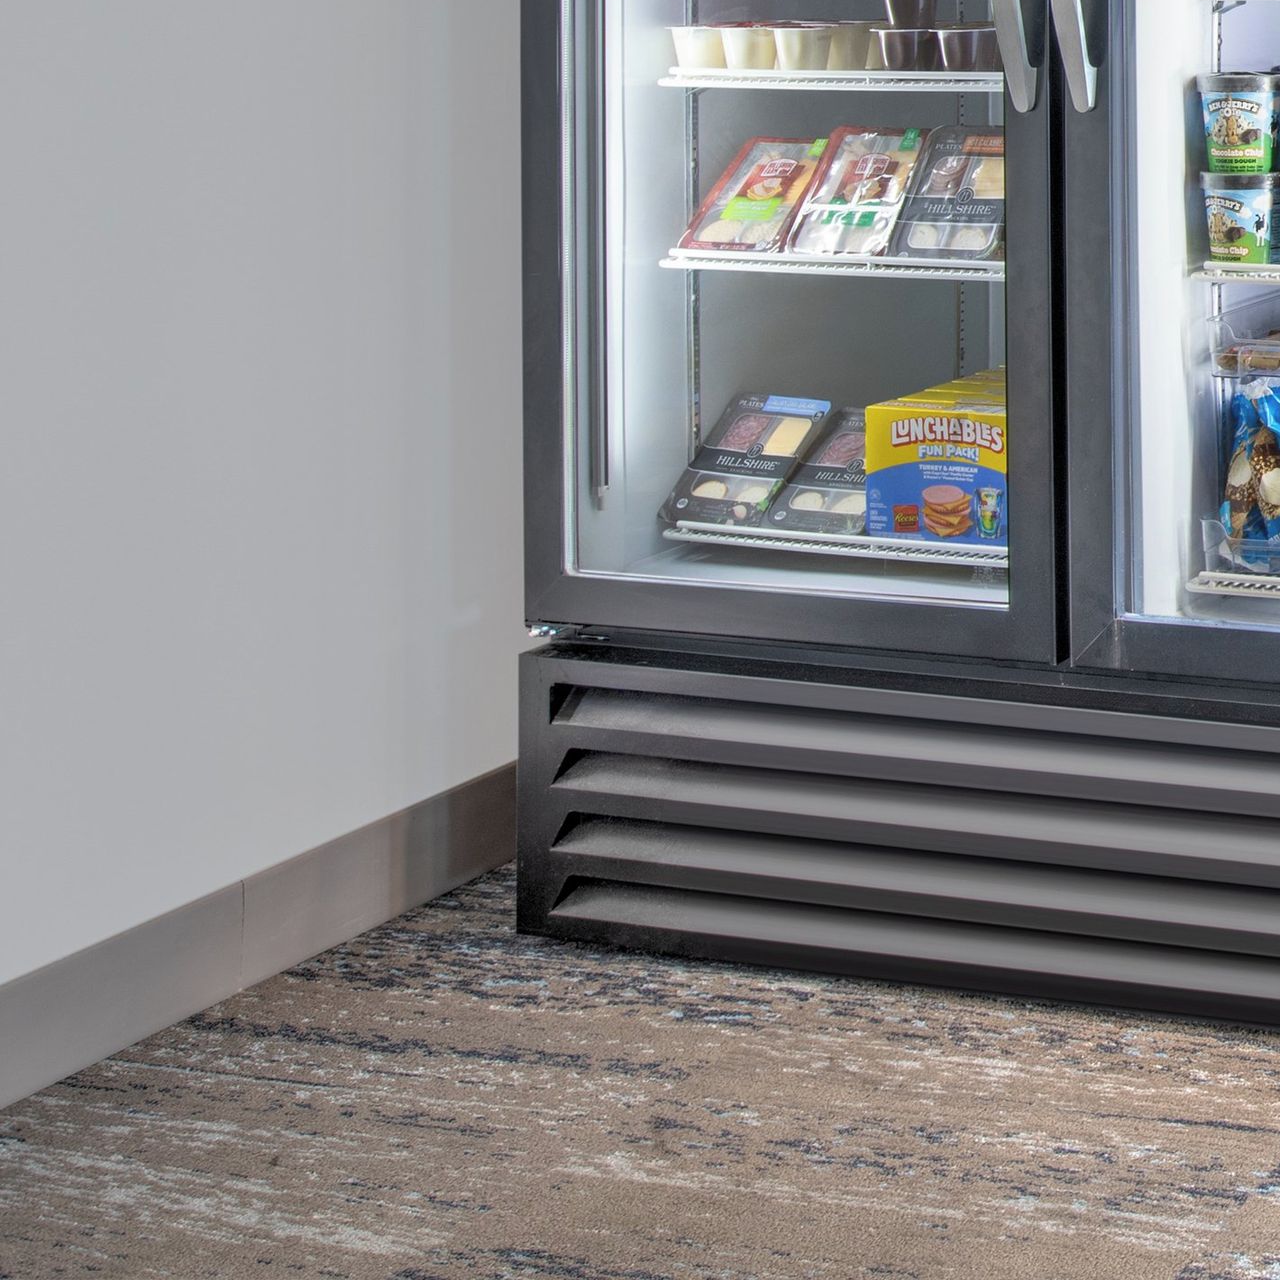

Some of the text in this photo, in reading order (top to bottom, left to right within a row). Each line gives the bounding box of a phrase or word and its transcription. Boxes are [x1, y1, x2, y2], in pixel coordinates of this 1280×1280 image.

[935, 142, 963, 151] PLATES
[927, 203, 994, 216] HILLSHIRE
[738, 399, 765, 409] PLATES
[890, 417, 1005, 453] LUNCHABLES
[918, 444, 980, 462] FUN PACK!
[715, 455, 778, 471] HILLSHIRE
[918, 463, 979, 474] TURKEY AMERICAN
[815, 470, 866, 484] HILLSHI
